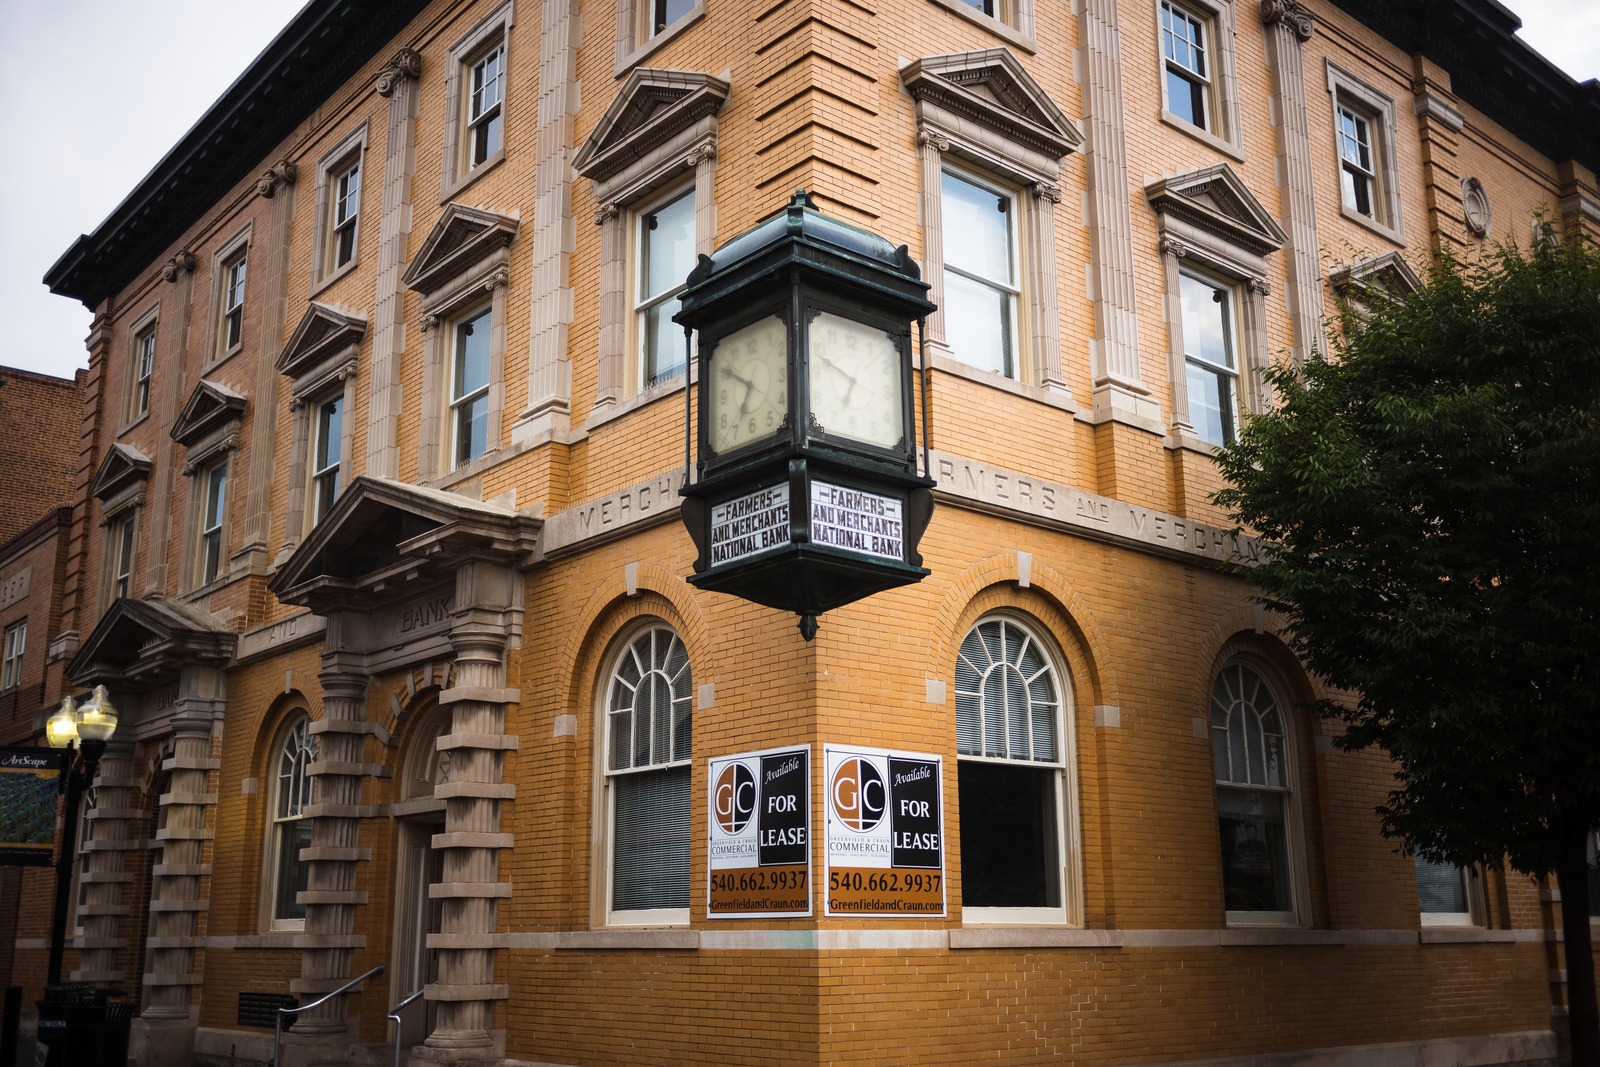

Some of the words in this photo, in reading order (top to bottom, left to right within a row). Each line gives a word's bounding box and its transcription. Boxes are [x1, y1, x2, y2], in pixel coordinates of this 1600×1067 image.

[1076, 496, 1110, 521] AND
[712, 526, 731, 544] AND
[732, 505, 789, 537] MERCHANTS
[812, 504, 835, 519] AND
[837, 508, 901, 538] MERCHANTS
[713, 536, 758, 563] NATIONAL
[762, 525, 789, 547] BANK
[813, 523, 869, 550] NATIONAL
[872, 536, 902, 557] BANK
[400, 595, 452, 633] BANK
[2, 754, 48, 768] ArtScape
[765, 756, 800, 785] Available
[894, 765, 931, 787] Available
[767, 794, 797, 813] FOR
[900, 799, 930, 818] FOR
[760, 827, 806, 847] LEASE
[830, 842, 890, 853] COMMERCIAL
[894, 832, 939, 850] LEASE
[712, 844, 757, 855] COMMERCIAL
[711, 870, 807, 892] 540.662.9937
[830, 871, 941, 893] 540.662.9937
[711, 898, 808, 911] GreenfieldandCraun.com
[830, 898, 943, 911] GreenfieldandCraun.com
